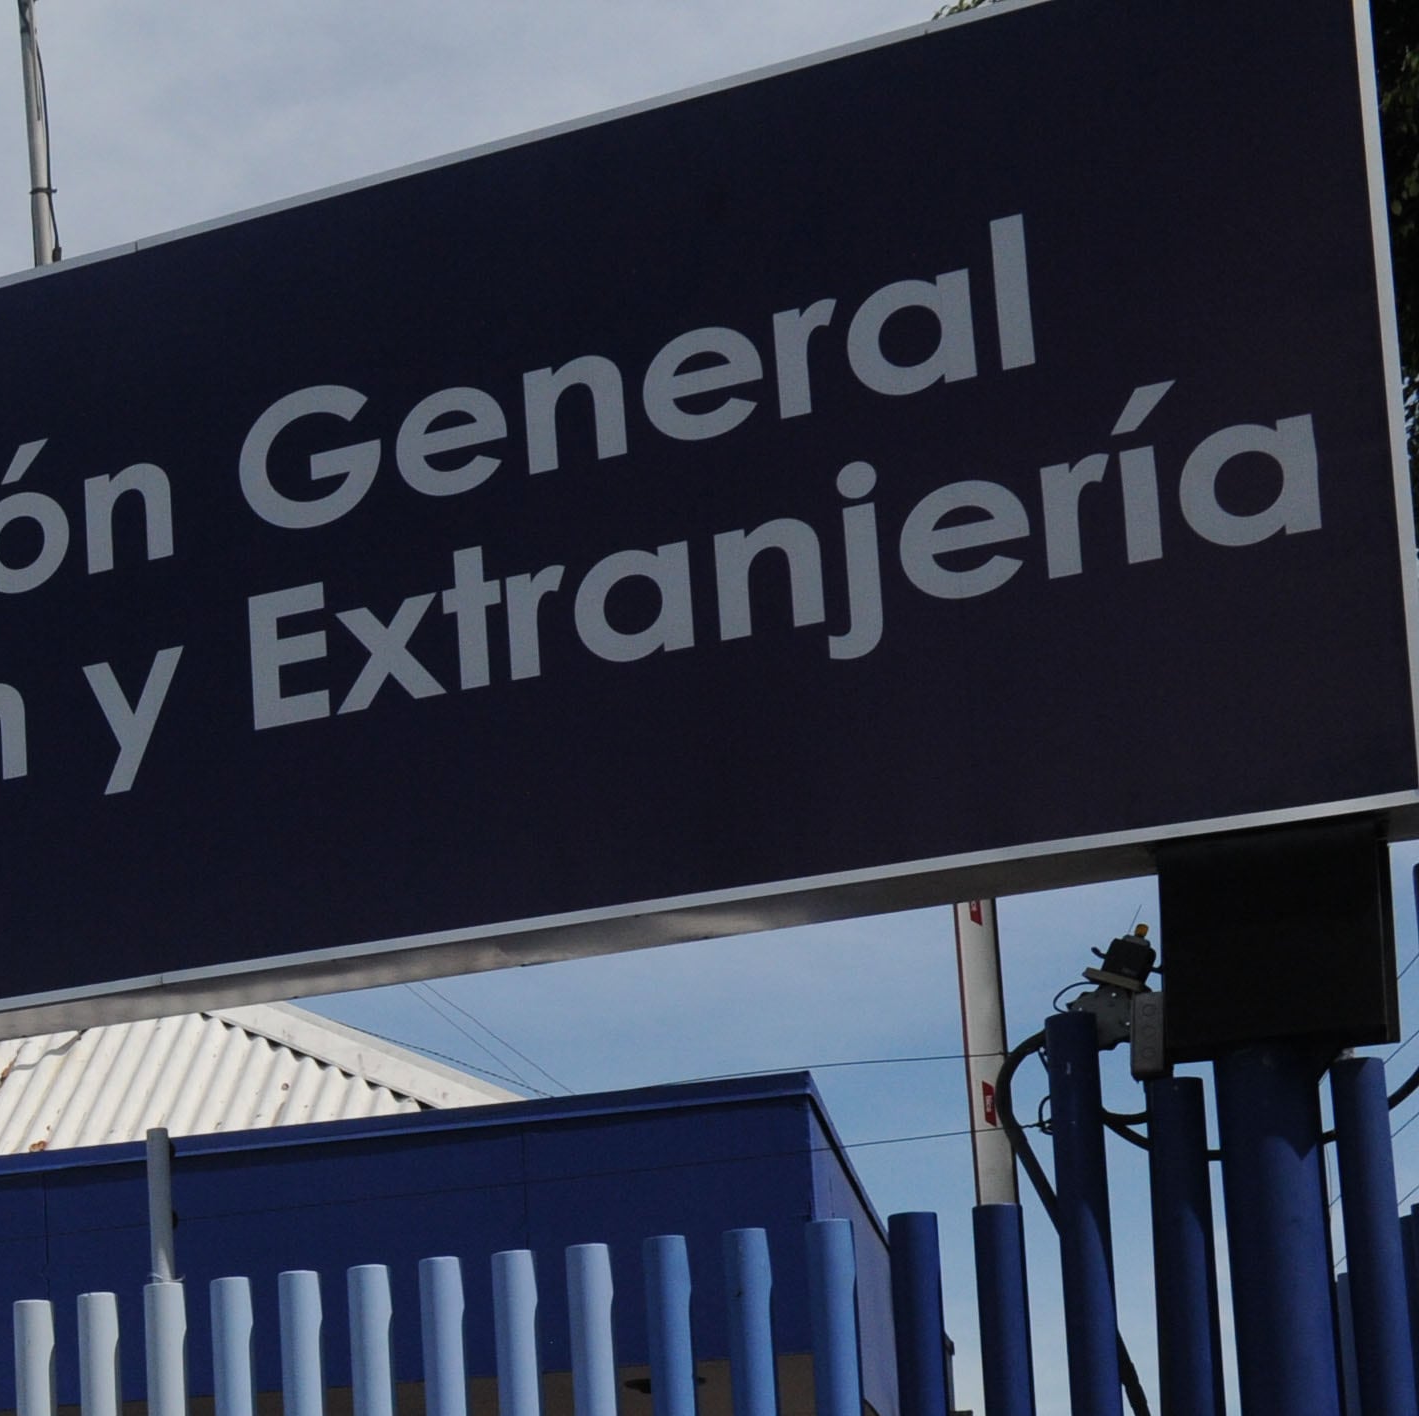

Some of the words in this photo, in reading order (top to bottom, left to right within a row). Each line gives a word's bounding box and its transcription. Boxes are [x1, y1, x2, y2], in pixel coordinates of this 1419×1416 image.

[238, 213, 1037, 529] General
[81, 645, 185, 795] y
[247, 380, 1323, 731] Extranjería
